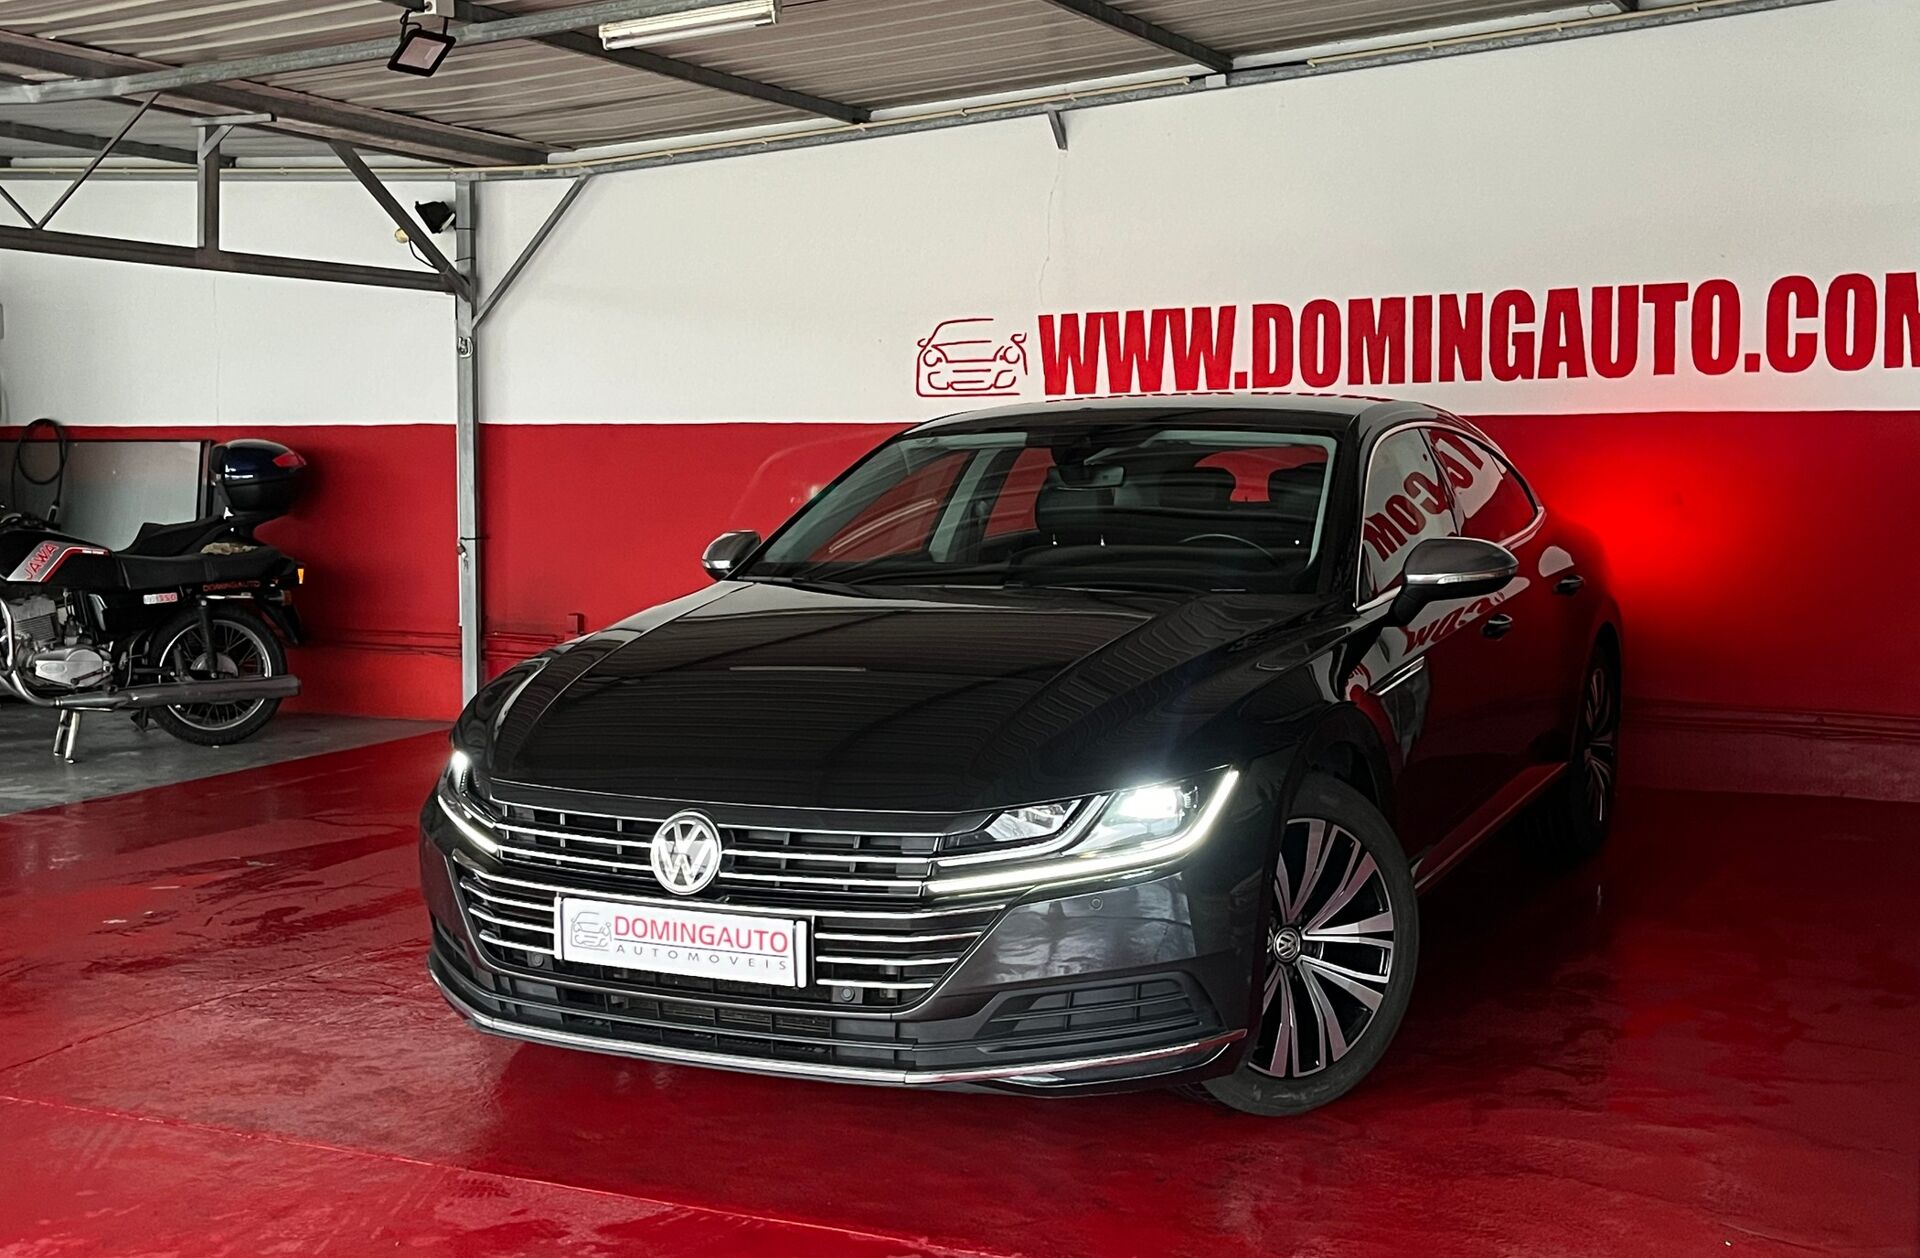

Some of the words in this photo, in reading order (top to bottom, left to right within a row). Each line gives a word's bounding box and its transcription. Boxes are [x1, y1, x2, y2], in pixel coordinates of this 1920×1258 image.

[24, 543, 59, 580] JAWA
[653, 815, 720, 891] VW
[614, 915, 788, 953] DOMINGAUTO
